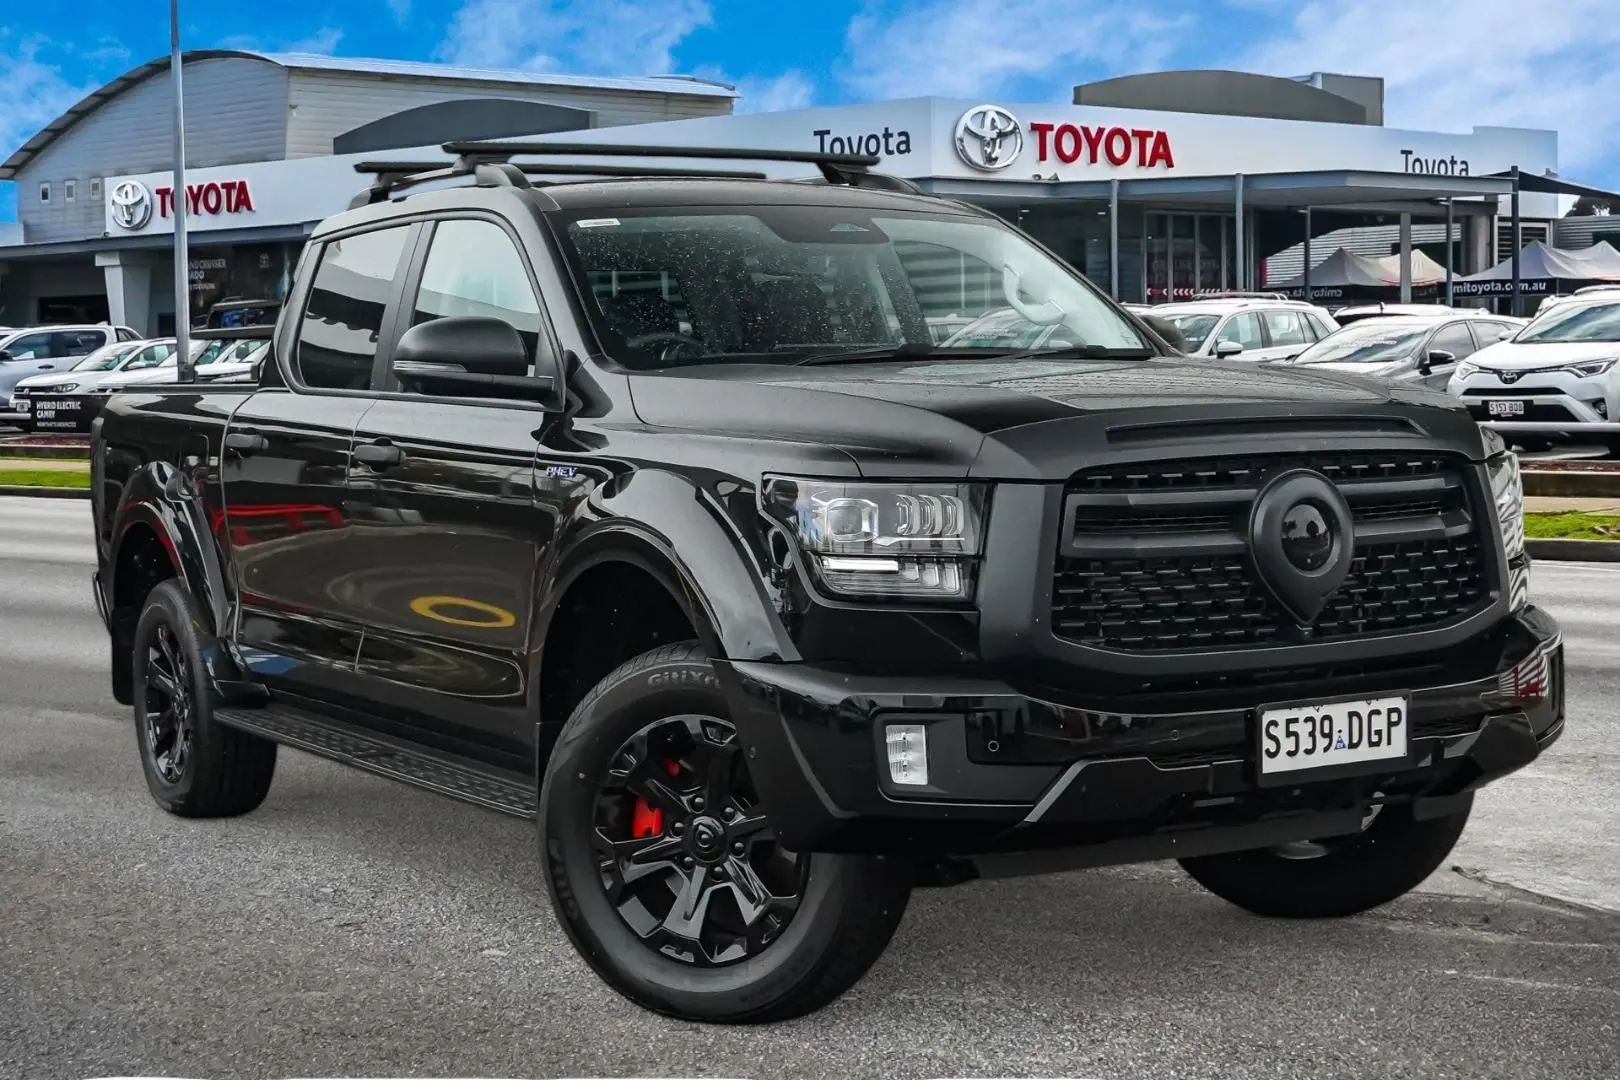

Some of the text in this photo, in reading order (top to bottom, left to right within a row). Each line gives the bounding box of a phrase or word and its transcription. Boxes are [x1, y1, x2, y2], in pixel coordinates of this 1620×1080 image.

[813, 127, 911, 156] Toyota
[1030, 122, 1175, 168] TOYOTA
[1453, 281, 1547, 294] mitoyota.cm.au
[546, 466, 577, 478] PHEV
[1265, 707, 1403, 759] S539 DGP
